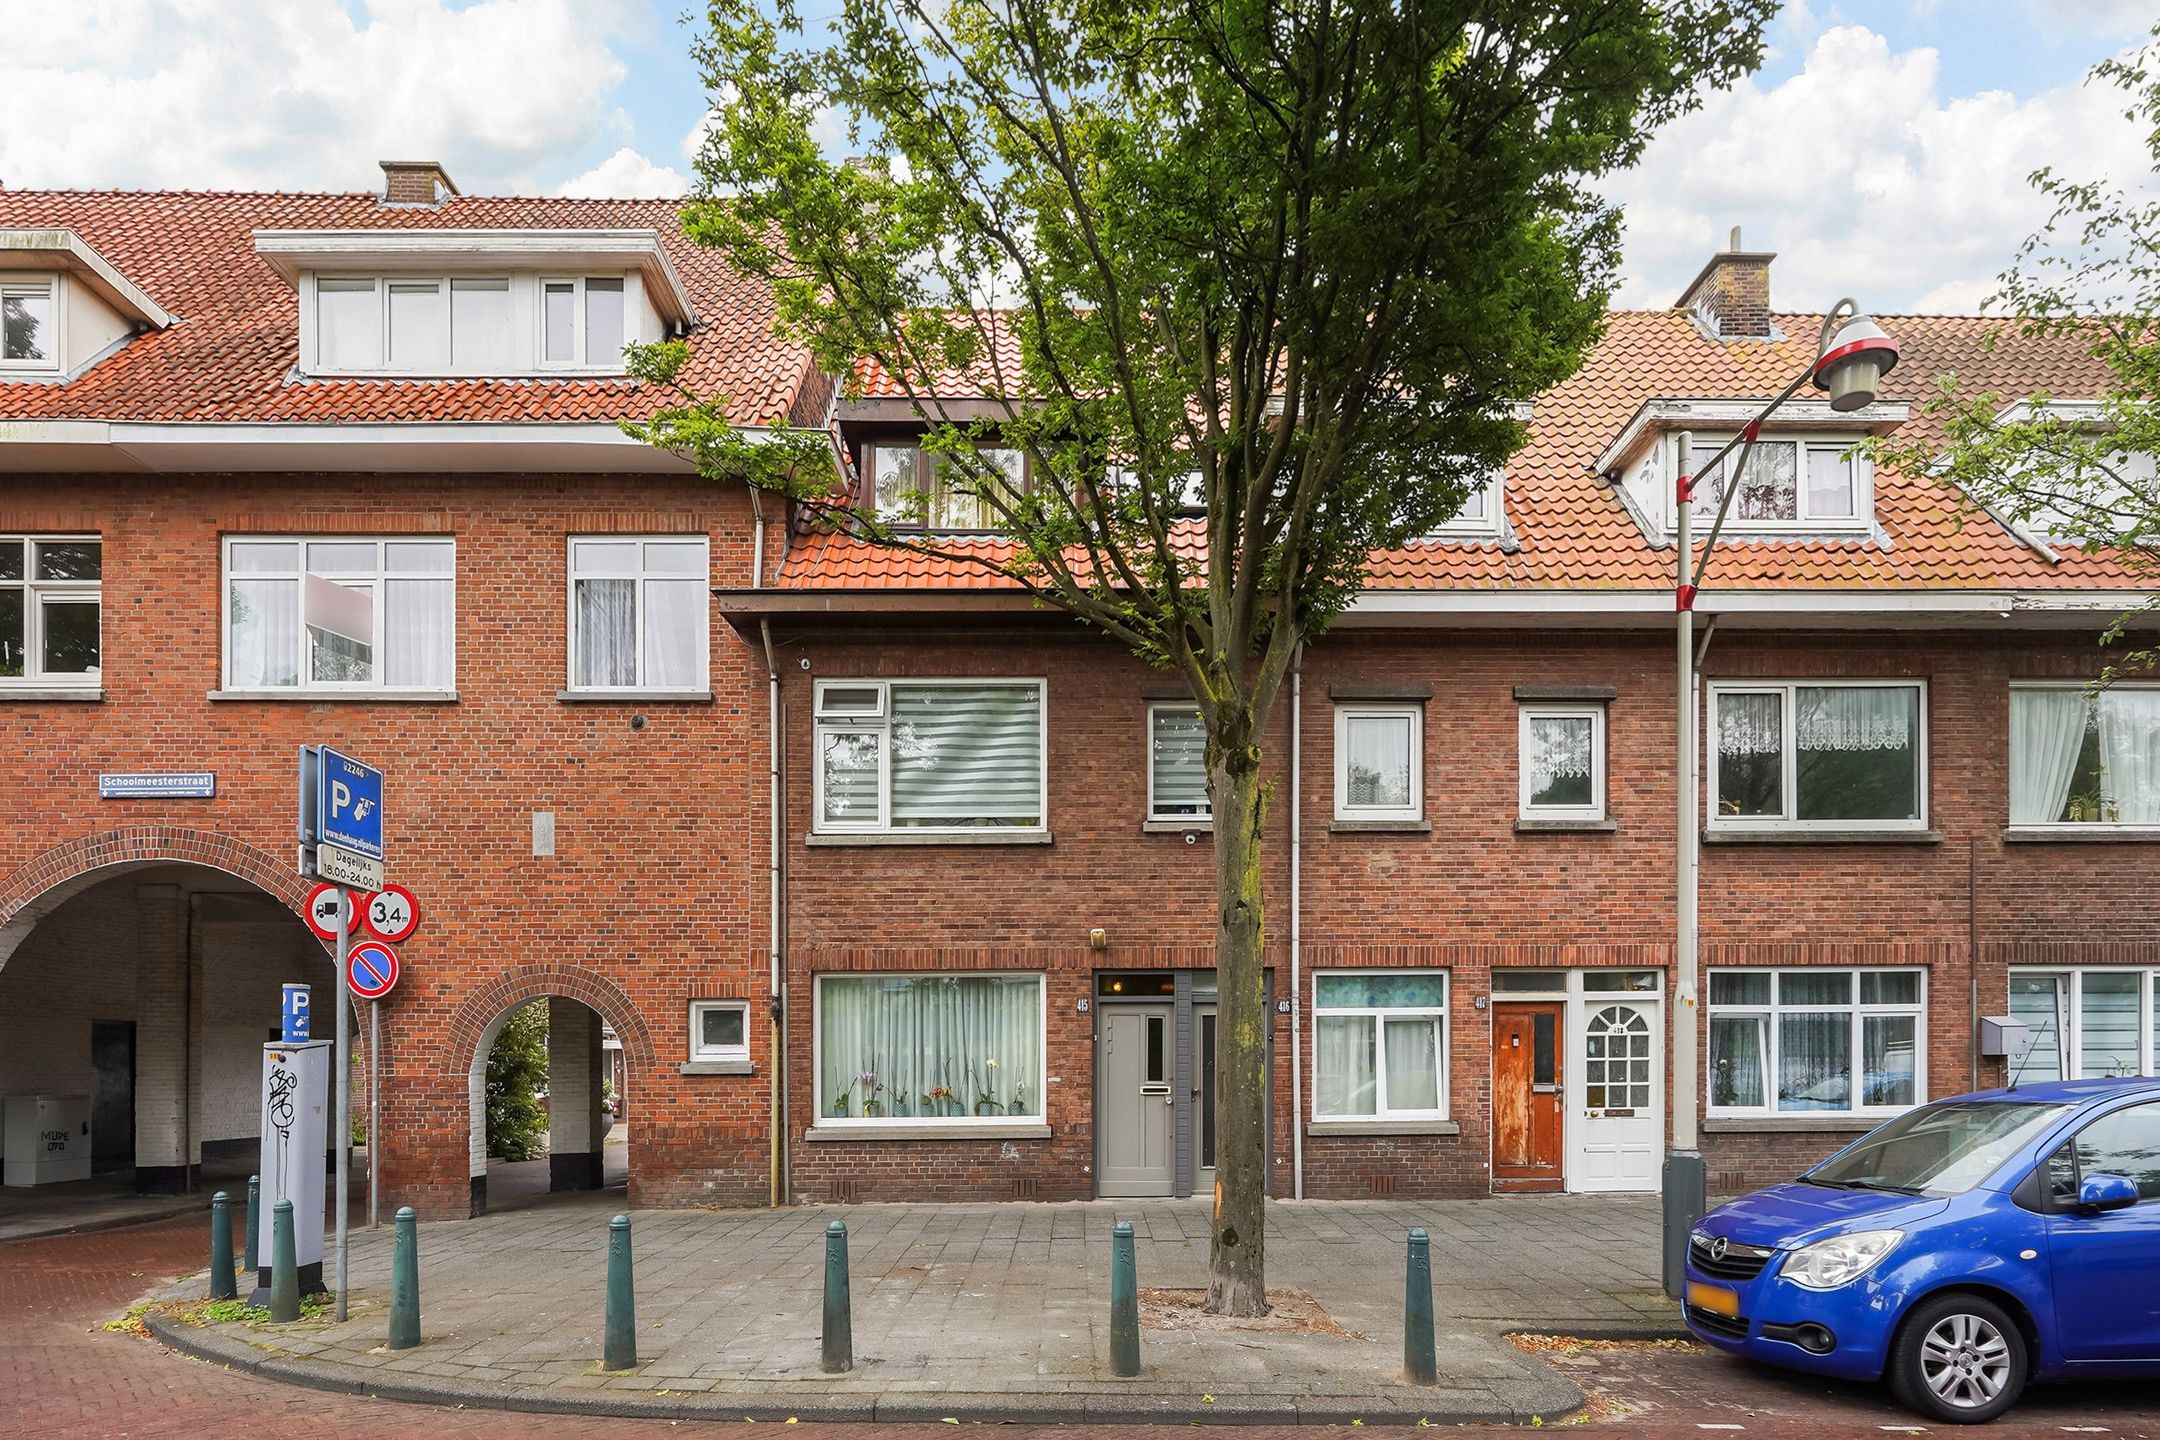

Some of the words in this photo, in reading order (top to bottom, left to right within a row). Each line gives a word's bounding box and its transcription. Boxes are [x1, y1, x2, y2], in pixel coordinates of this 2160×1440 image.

[104, 776, 209, 786] Schoolmeesterstraat
[332, 780, 351, 818] P
[336, 851, 372, 871] Dagelijks
[323, 863, 374, 887] 18.00-24.00
[292, 992, 310, 1015] P
[1077, 998, 1089, 1012] 415
